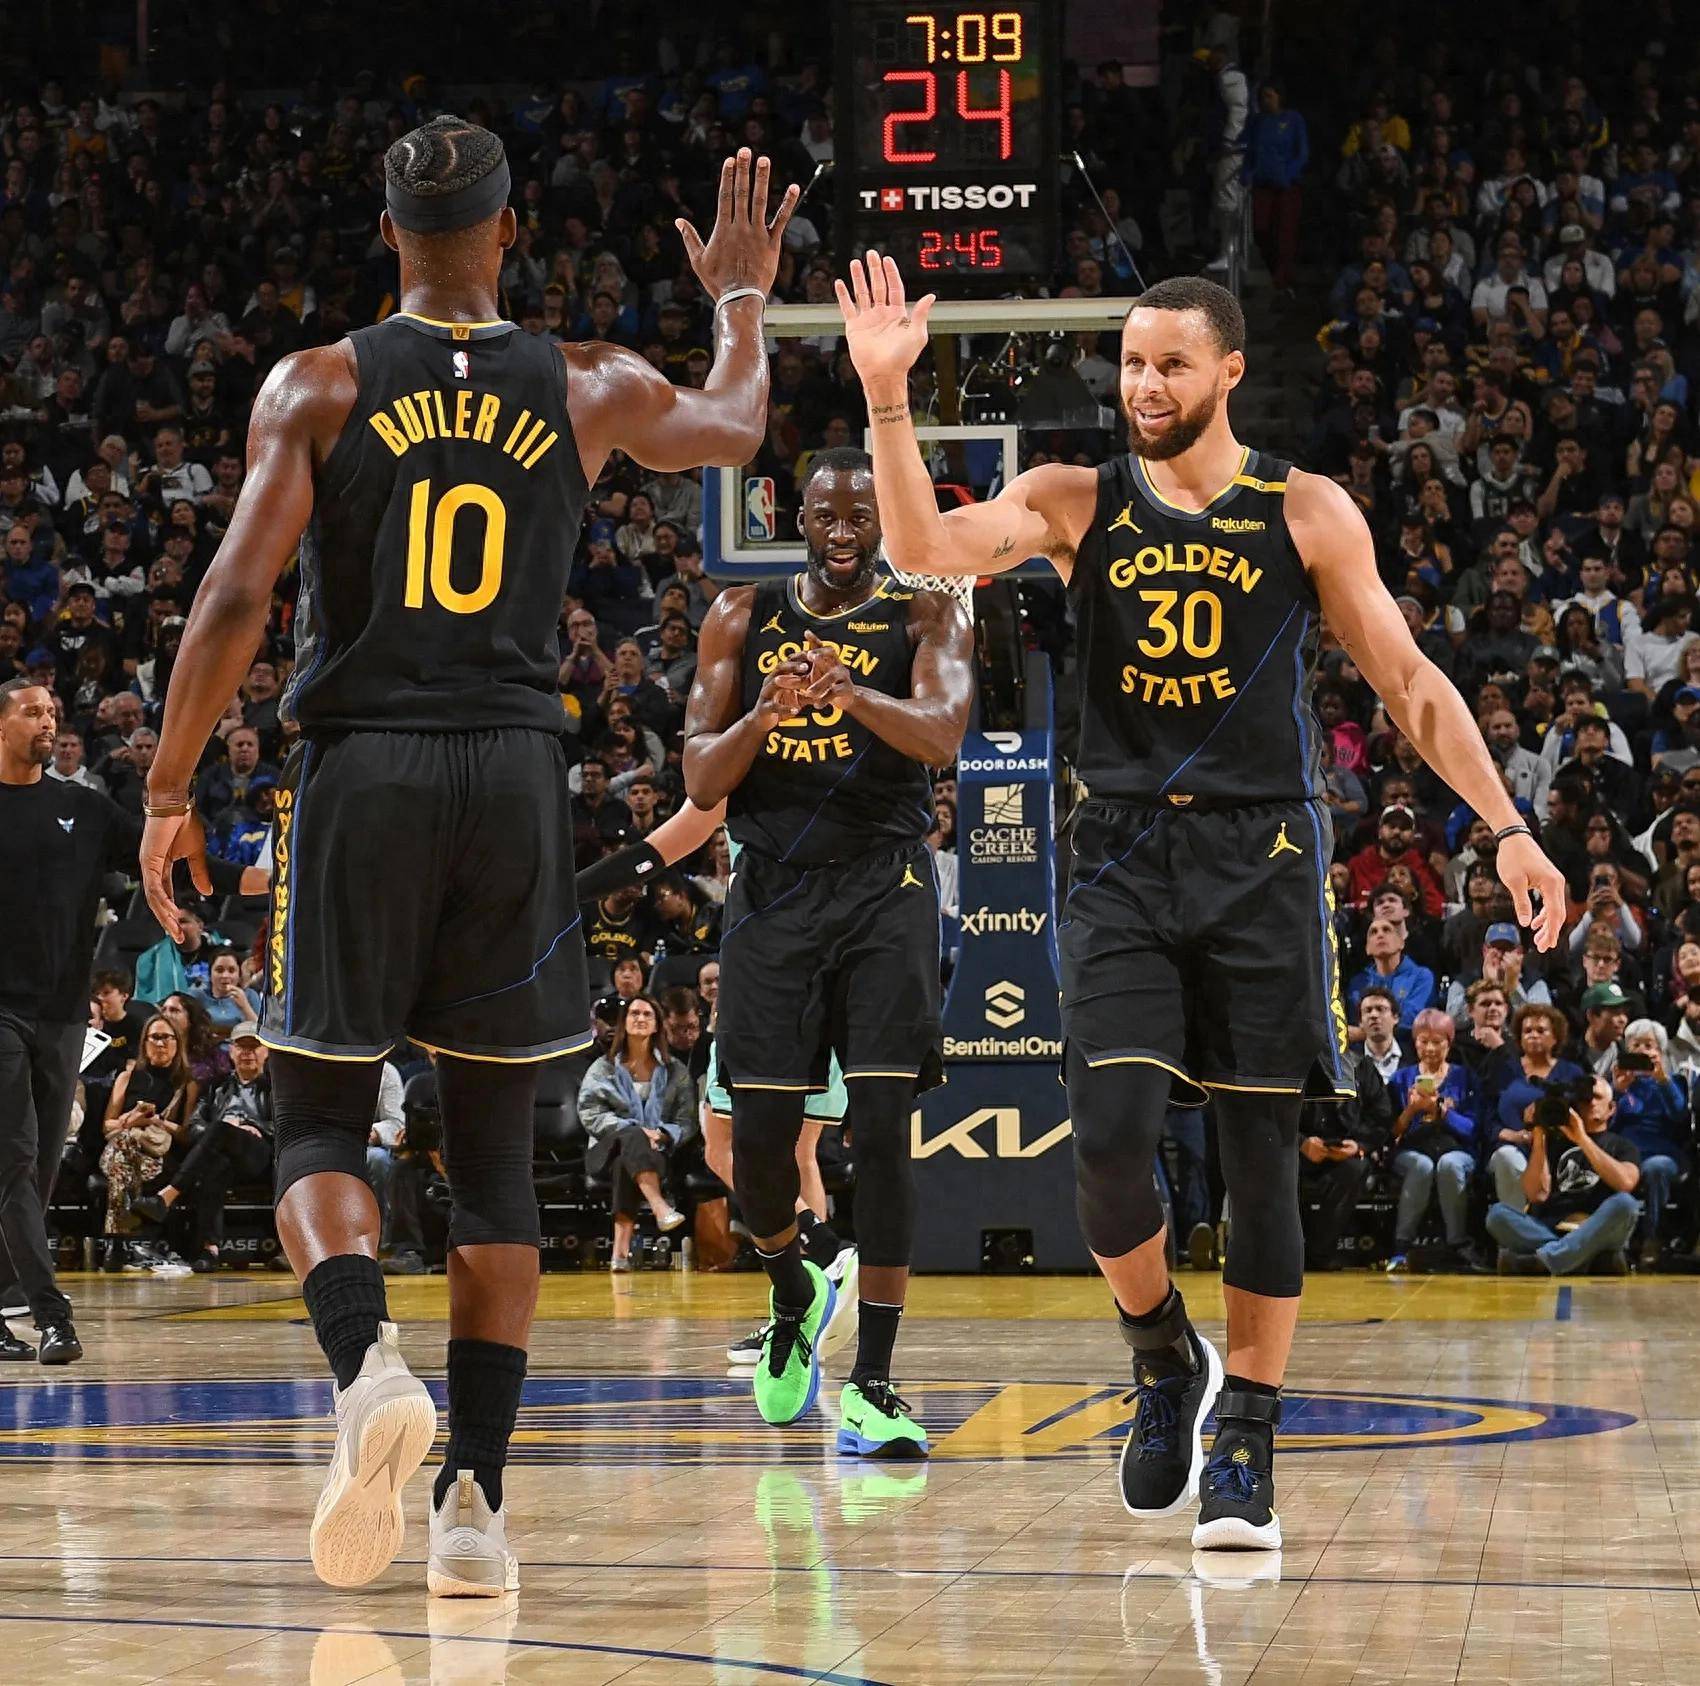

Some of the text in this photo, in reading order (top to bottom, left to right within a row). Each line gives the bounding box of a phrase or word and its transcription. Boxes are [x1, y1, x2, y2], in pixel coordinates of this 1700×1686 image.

[906, 13, 1021, 63] 7:09
[883, 69, 1010, 162] 24
[907, 184, 1036, 210] TISSOT
[919, 230, 1001, 268] 2:45
[369, 390, 558, 470] BUTLER III
[1211, 517, 1266, 531] Rakuten
[404, 478, 506, 614] 10
[1109, 543, 1263, 593] GOLDEN
[847, 621, 890, 631] Rakuten
[1137, 590, 1222, 659] 30
[1121, 664, 1236, 707] STATE
[766, 731, 853, 763] STATE
[970, 827, 1037, 842] CACHE
[970, 842, 1037, 855] CREEK
[971, 855, 1003, 864] CASINO
[271, 789, 293, 996] WARRIORS
[960, 906, 1047, 935] xfinity
[591, 932, 636, 948] GOLDEN
